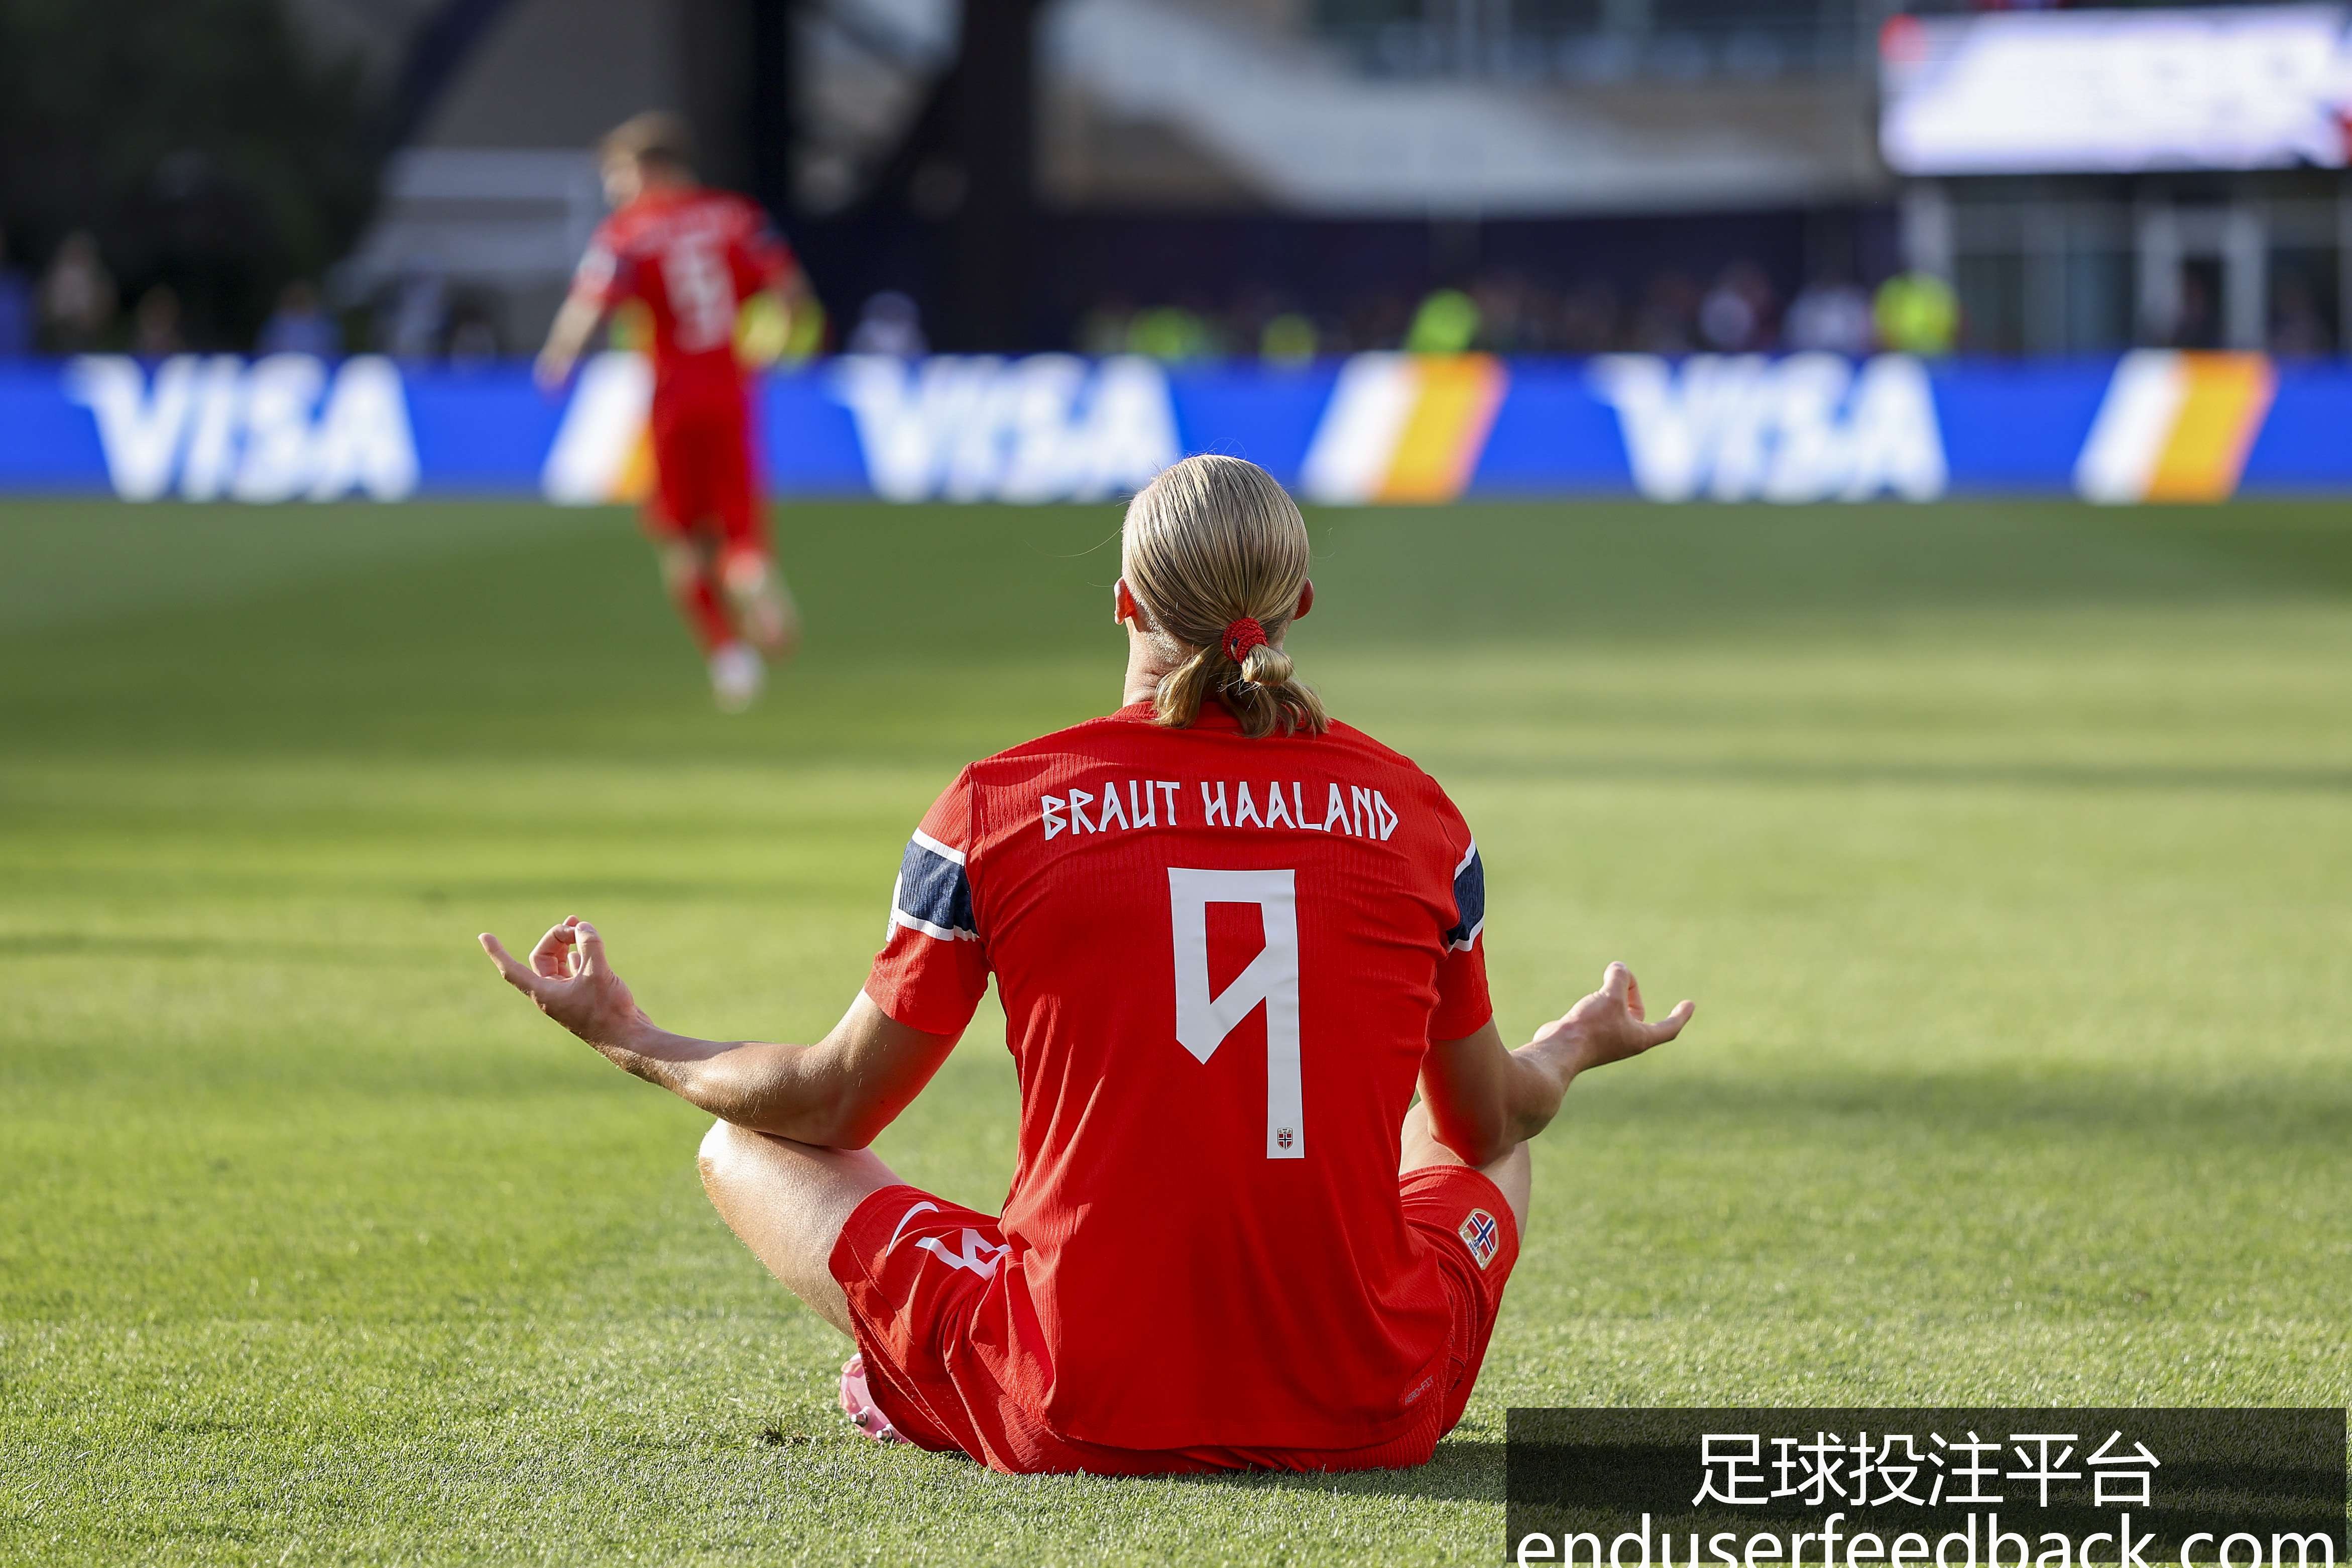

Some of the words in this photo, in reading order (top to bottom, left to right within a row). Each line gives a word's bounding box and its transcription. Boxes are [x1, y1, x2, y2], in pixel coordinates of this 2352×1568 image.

[70, 354, 418, 501] VISA
[829, 354, 1181, 502] VISA
[1591, 354, 1947, 501] VISA
[1041, 780, 1181, 841] BRAUT
[1201, 781, 1399, 841] HAALAND
[1168, 868, 1305, 1159] 9
